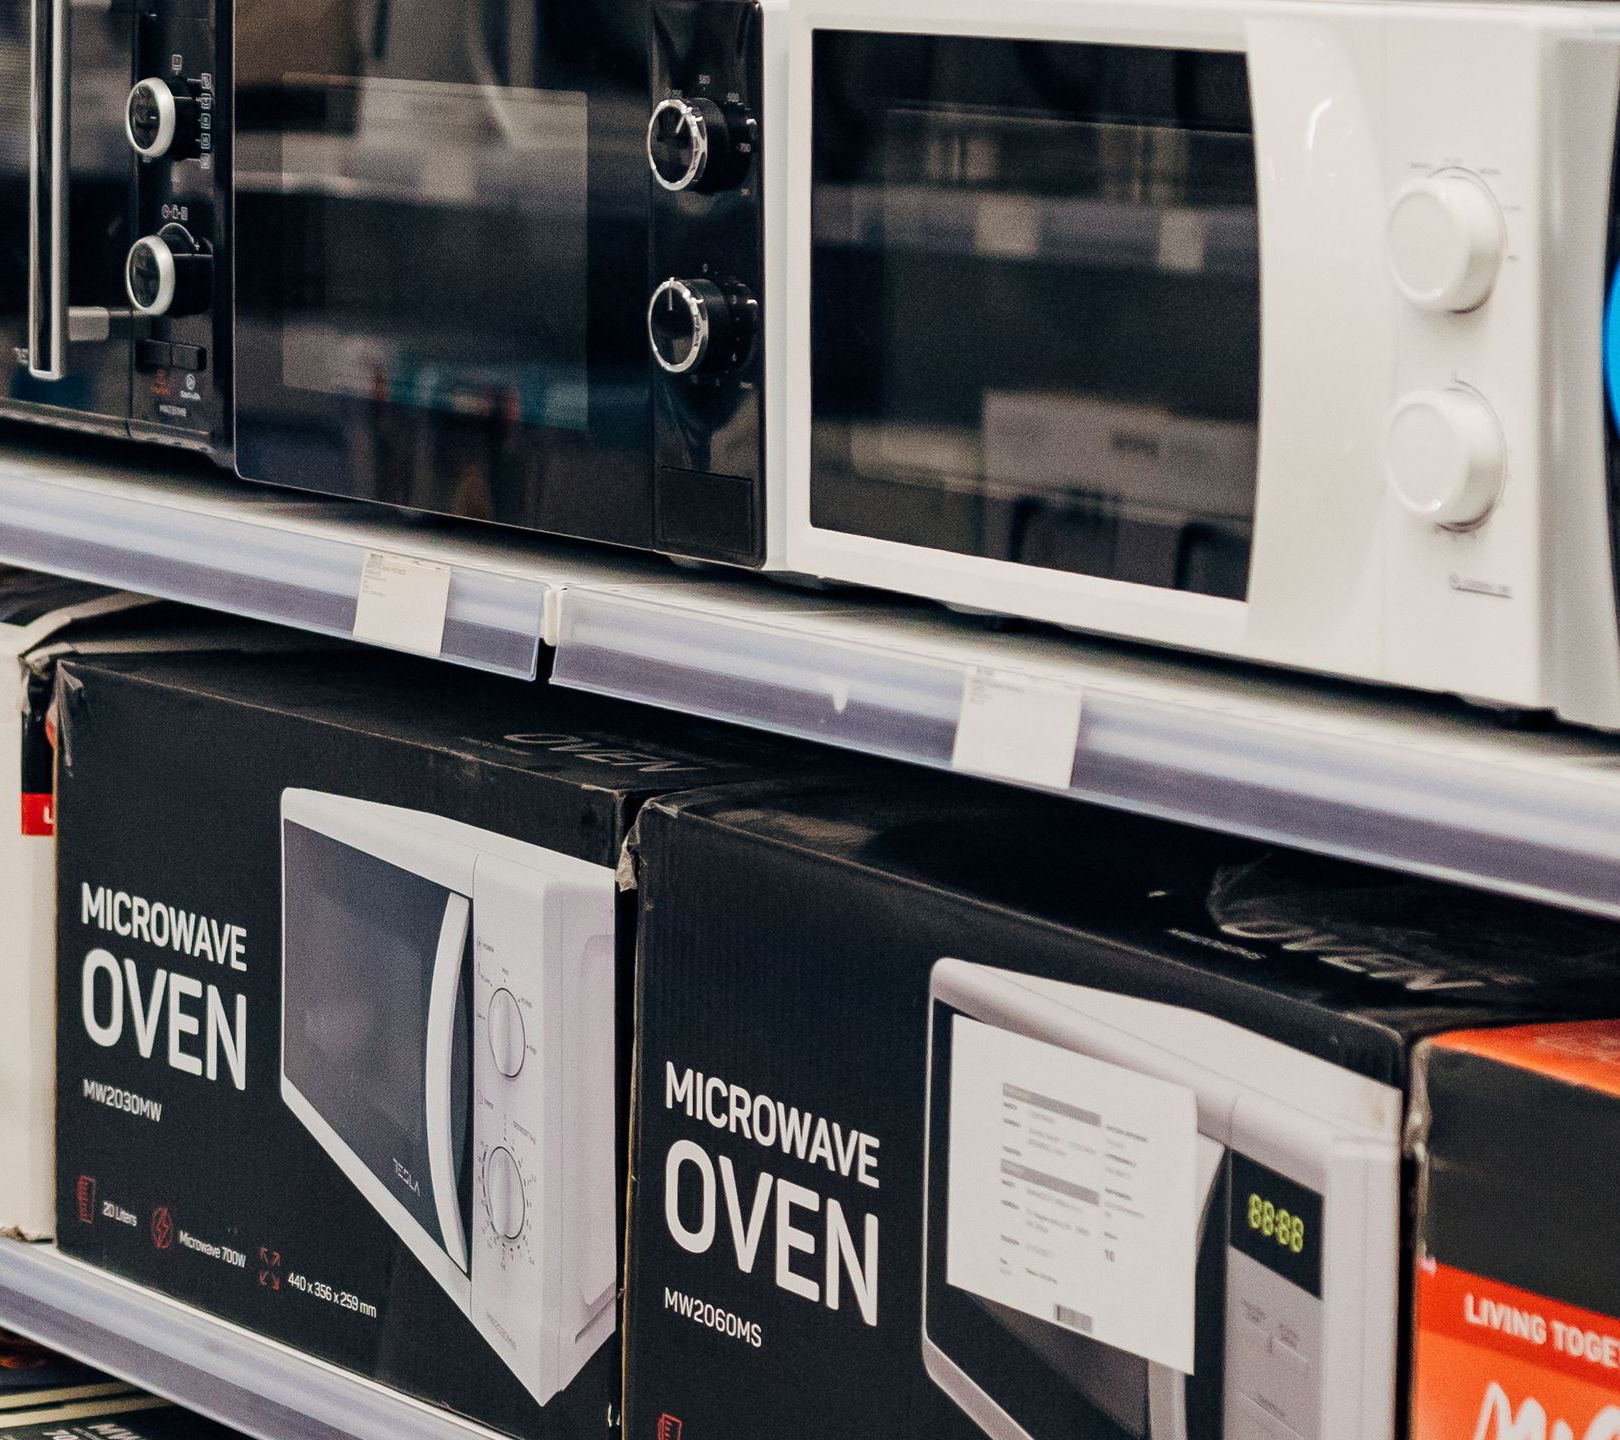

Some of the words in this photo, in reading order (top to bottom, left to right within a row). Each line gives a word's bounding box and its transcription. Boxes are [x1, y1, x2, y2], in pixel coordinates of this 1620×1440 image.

[81, 881, 248, 972] MICROWAVE
[81, 947, 248, 1092] OVEN
[82, 1078, 163, 1123] MW2030MW
[665, 1060, 881, 1189] MICROWAVE
[115, 1205, 138, 1228] Liters
[664, 1138, 880, 1328] OVEN
[178, 1229, 221, 1260] Microwave
[221, 1246, 247, 1269] 700W
[287, 1271, 307, 1292] 440
[313, 1280, 333, 1303] 356
[339, 1291, 359, 1312] 259
[359, 1301, 378, 1319] mm
[664, 1286, 763, 1349] MW2060MS
[1463, 1292, 1549, 1347] LIVING
